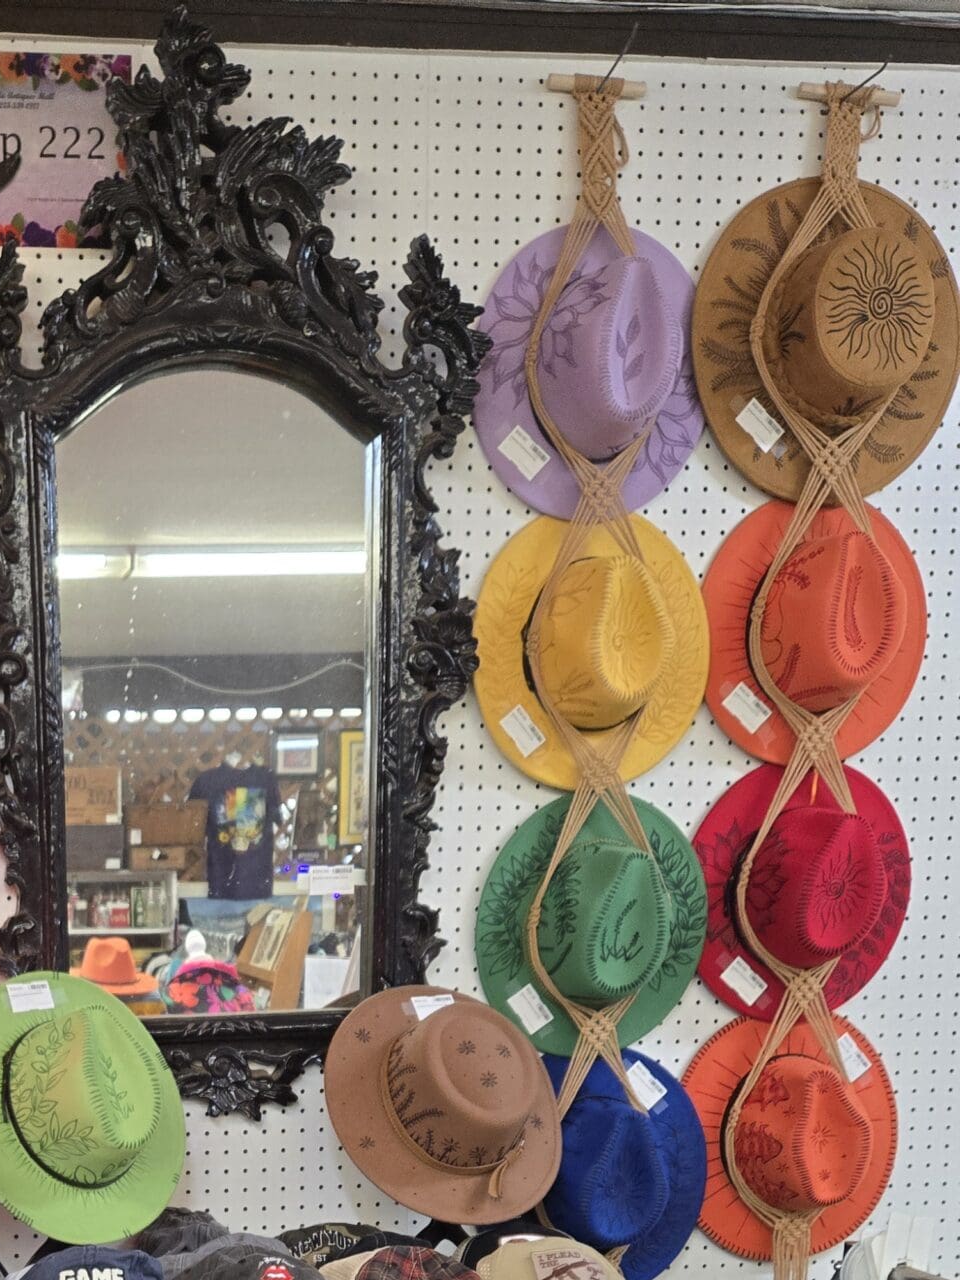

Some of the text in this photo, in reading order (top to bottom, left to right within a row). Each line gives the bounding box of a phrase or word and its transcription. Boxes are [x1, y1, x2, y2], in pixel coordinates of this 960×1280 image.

[39, 126, 105, 159] 222
[288, 1230, 323, 1260] NEW
[546, 1251, 581, 1261] PLEAD
